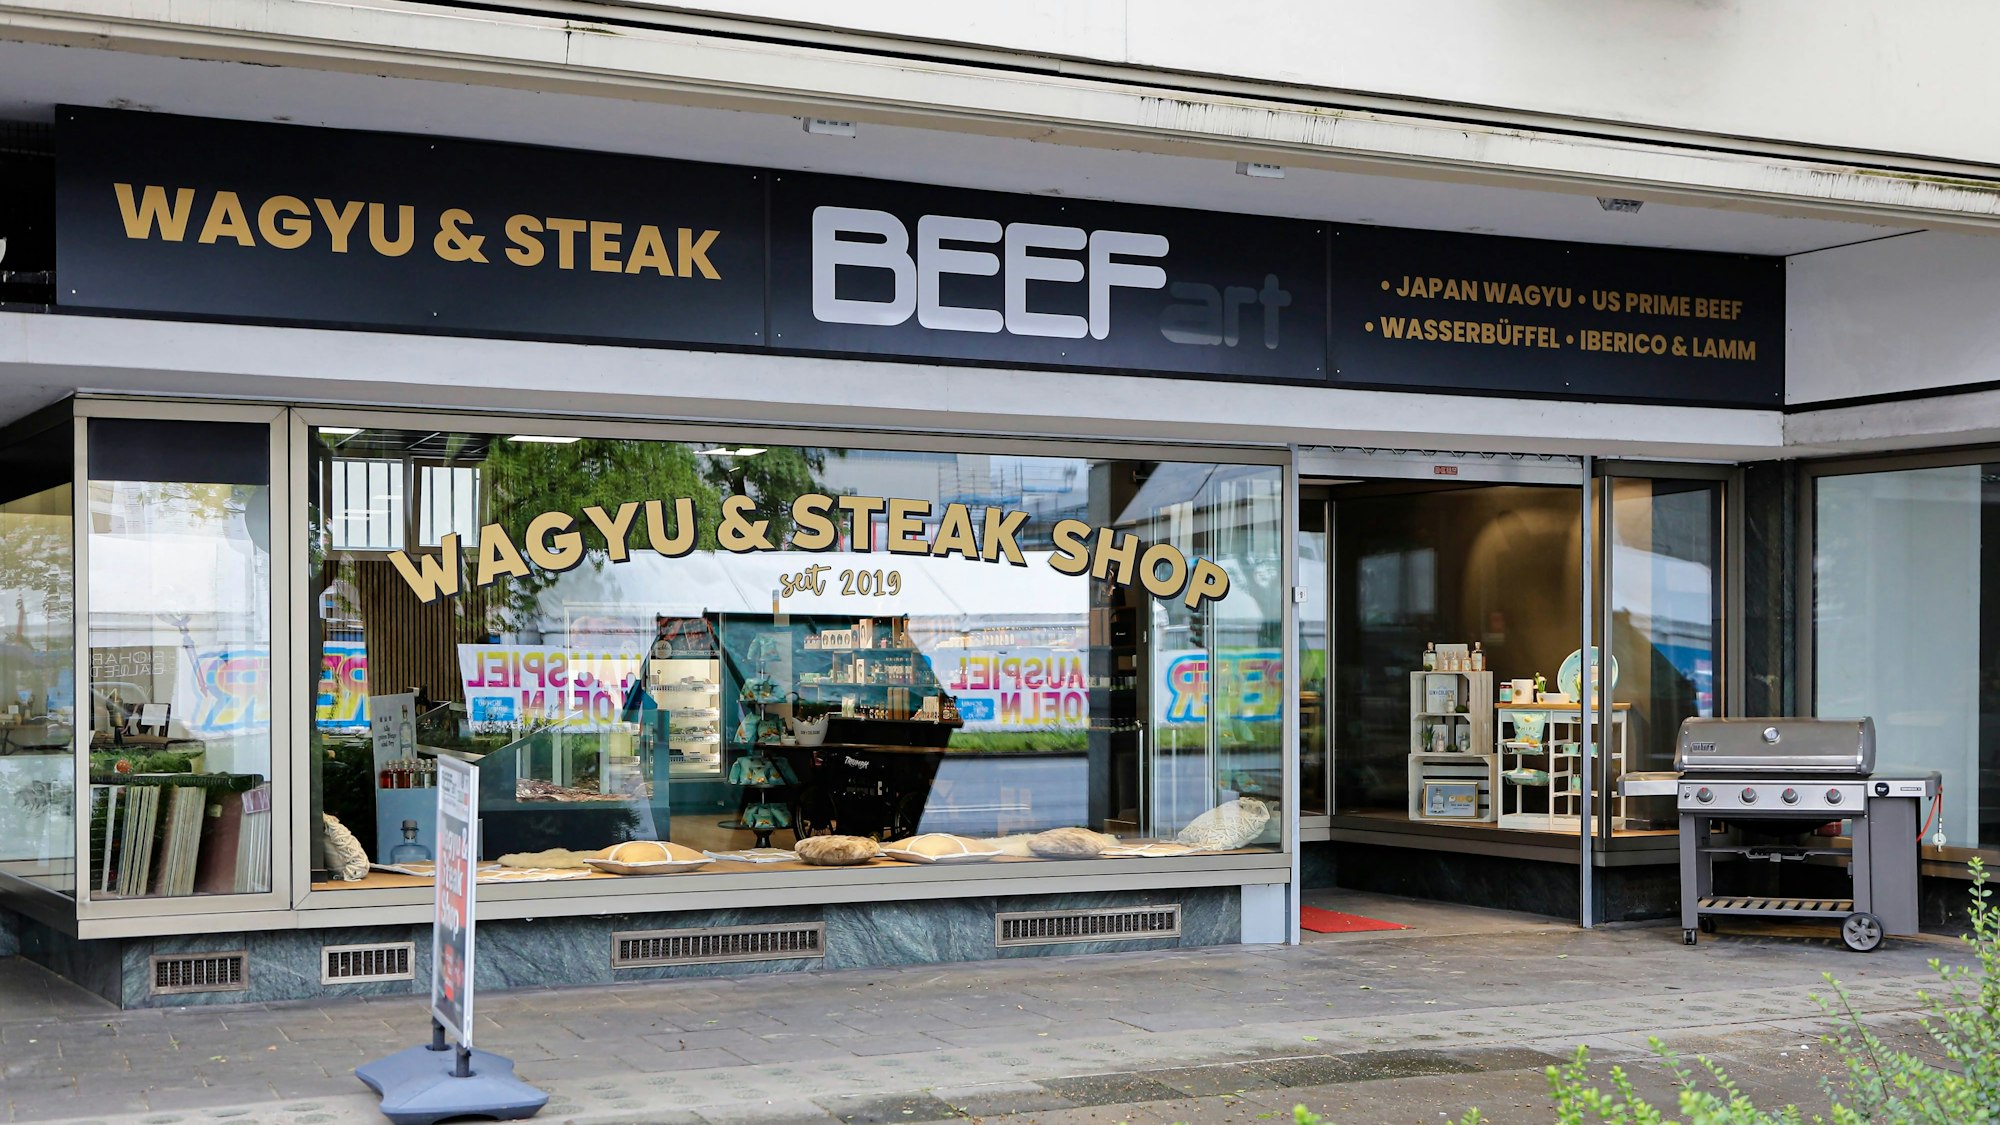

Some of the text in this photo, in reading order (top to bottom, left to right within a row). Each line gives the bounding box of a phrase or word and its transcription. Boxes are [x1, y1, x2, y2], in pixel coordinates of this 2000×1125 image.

[114, 183, 722, 280] WAGYU & STEAK
[812, 205, 1292, 350] BEEF art
[1396, 275, 1743, 320] JAPAN WAGYU US PRIME BEEF
[1380, 316, 1757, 361] WASSERBÜFFEL IBERICO & LAMM
[387, 493, 1231, 610] WAGYU & STEAK SHOP
[780, 563, 902, 598] seit 2019
